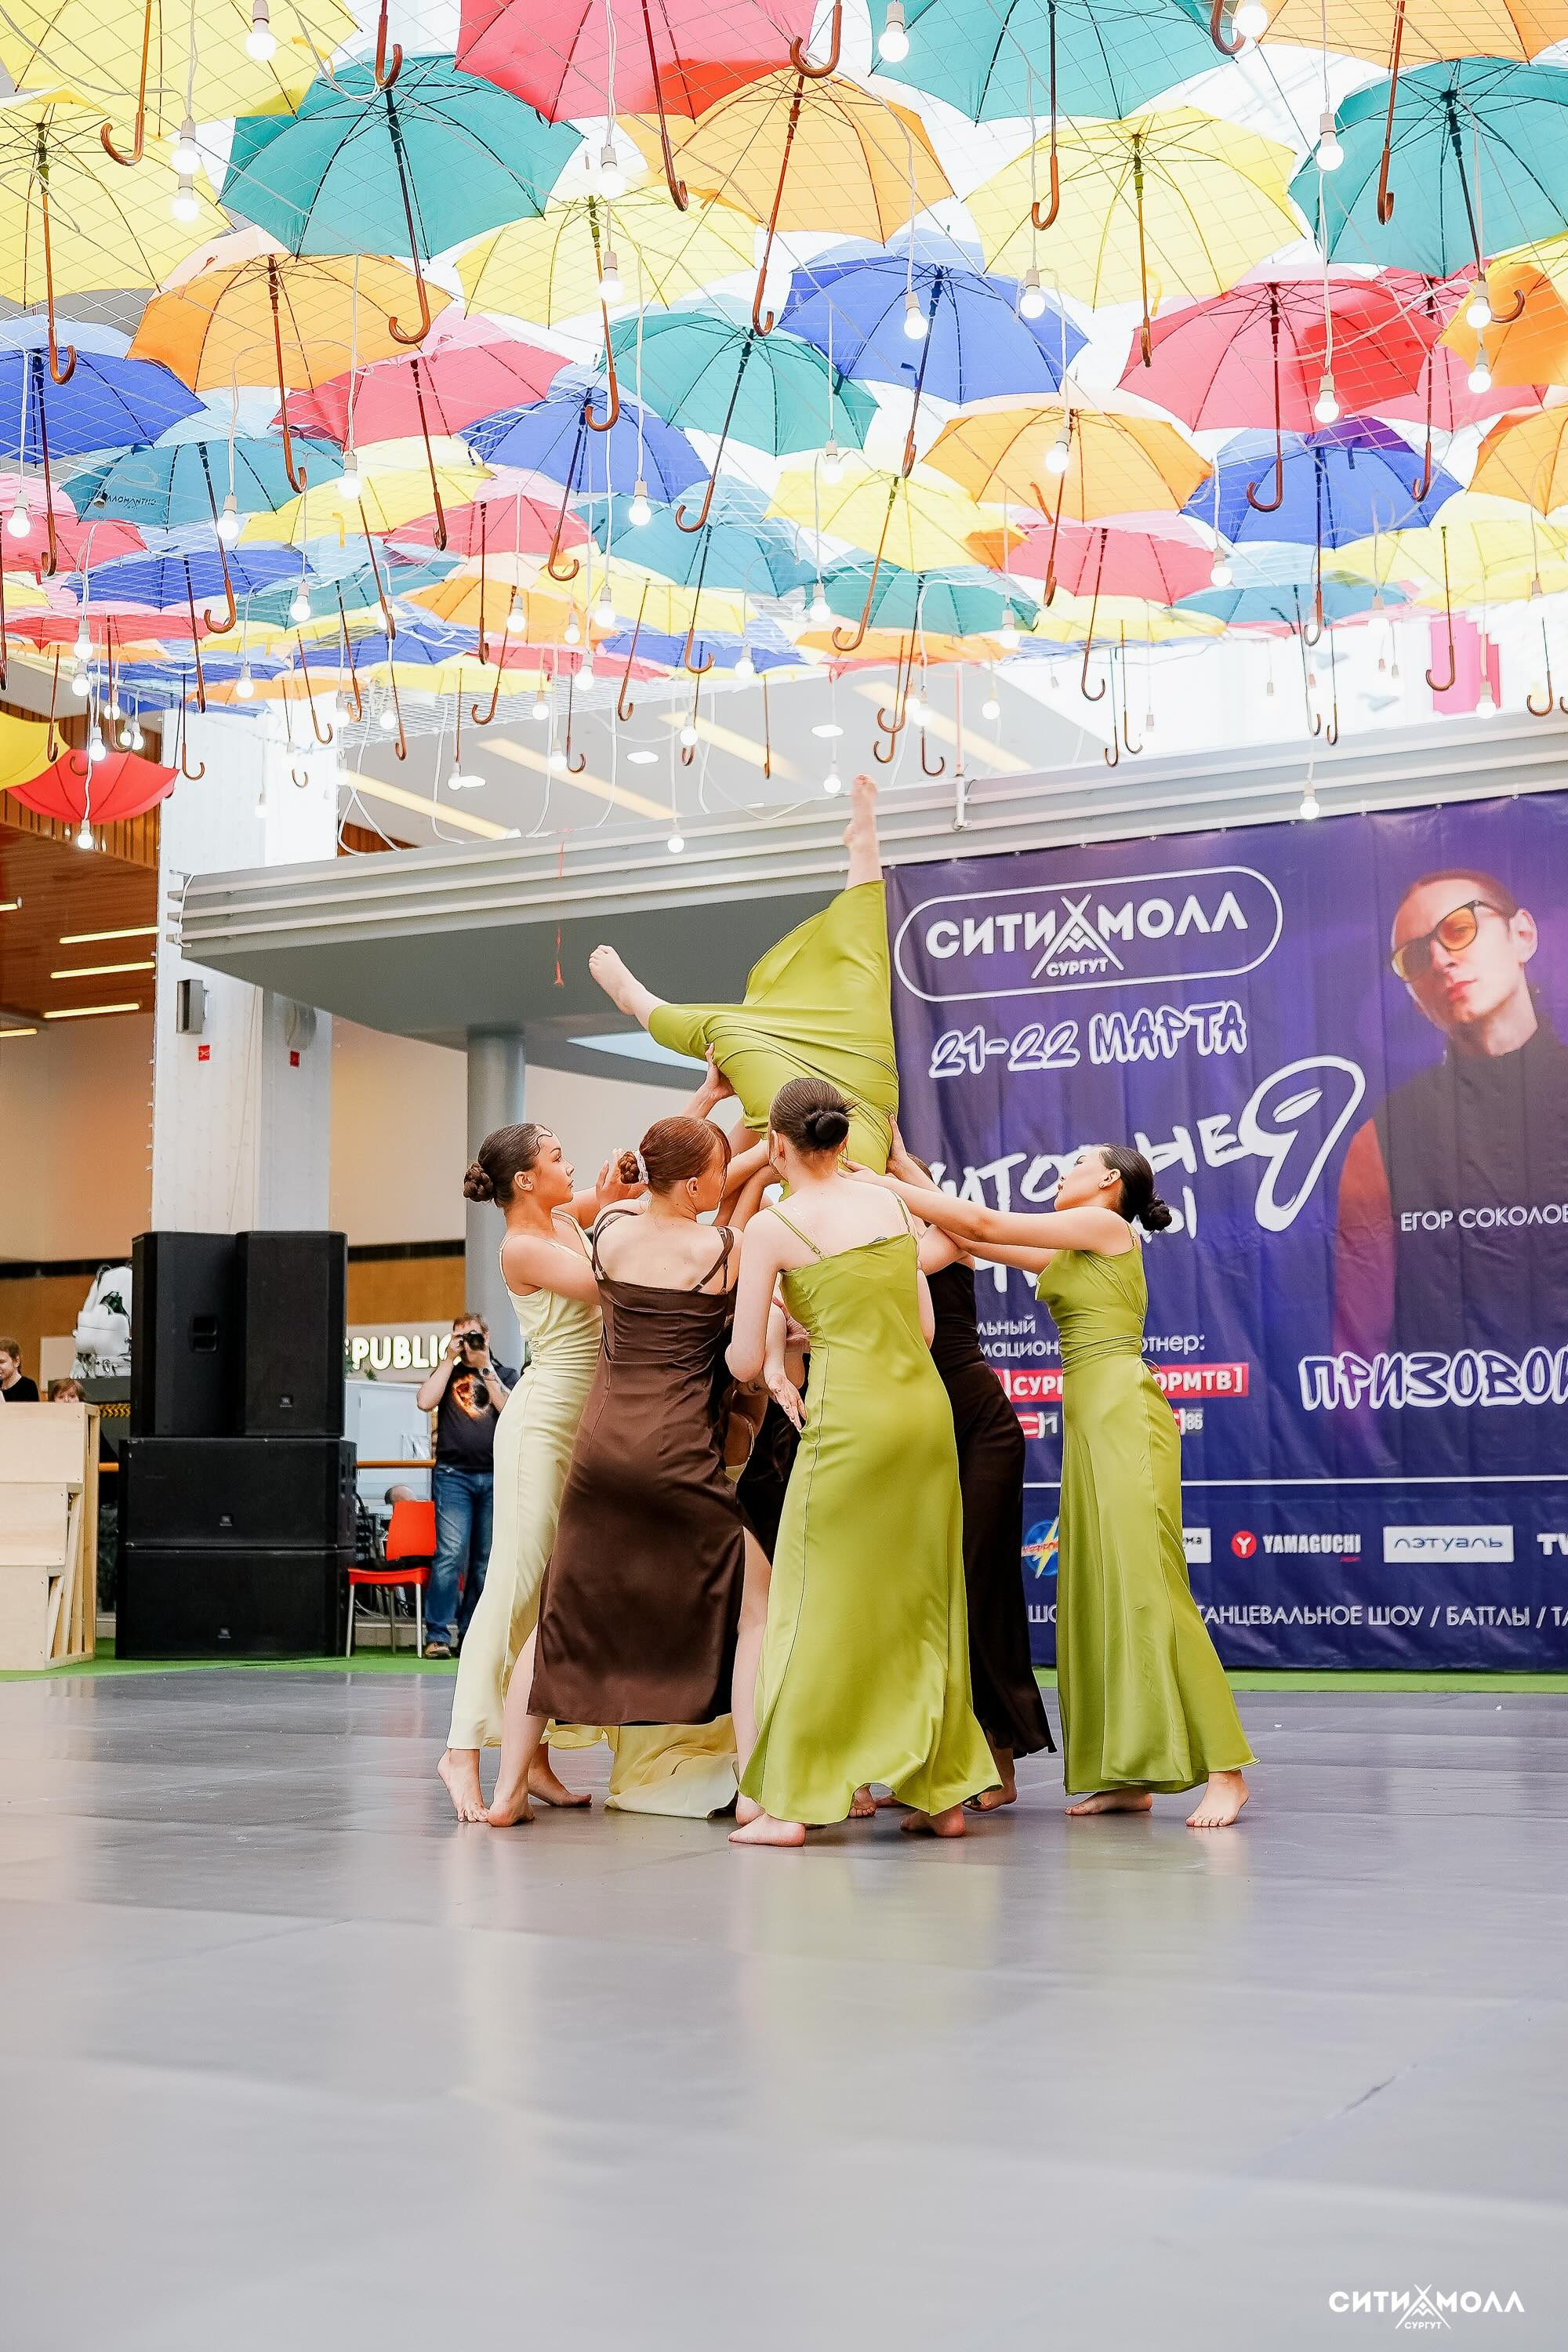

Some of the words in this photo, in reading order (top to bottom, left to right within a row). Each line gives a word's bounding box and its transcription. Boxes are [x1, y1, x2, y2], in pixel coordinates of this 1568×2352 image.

[1046, 956, 1108, 978] СУРГУТ
[928, 1019, 1081, 1079] 21-22
[1088, 1000, 1248, 1065] МАРТА
[1400, 1210, 1454, 1232] ЕГОР
[977, 1314, 1036, 1336] льный
[344, 1334, 462, 1370] PUBLI
[1142, 1334, 1206, 1355] тнер:
[1262, 1534, 1362, 1554] YAMAGUCHI
[1197, 1605, 1363, 1628] ТАНЦЕВАЛЬНОЕ
[1368, 1605, 1425, 1626] ШОУ
[1446, 1605, 1530, 1626] БАТТЛЫ
